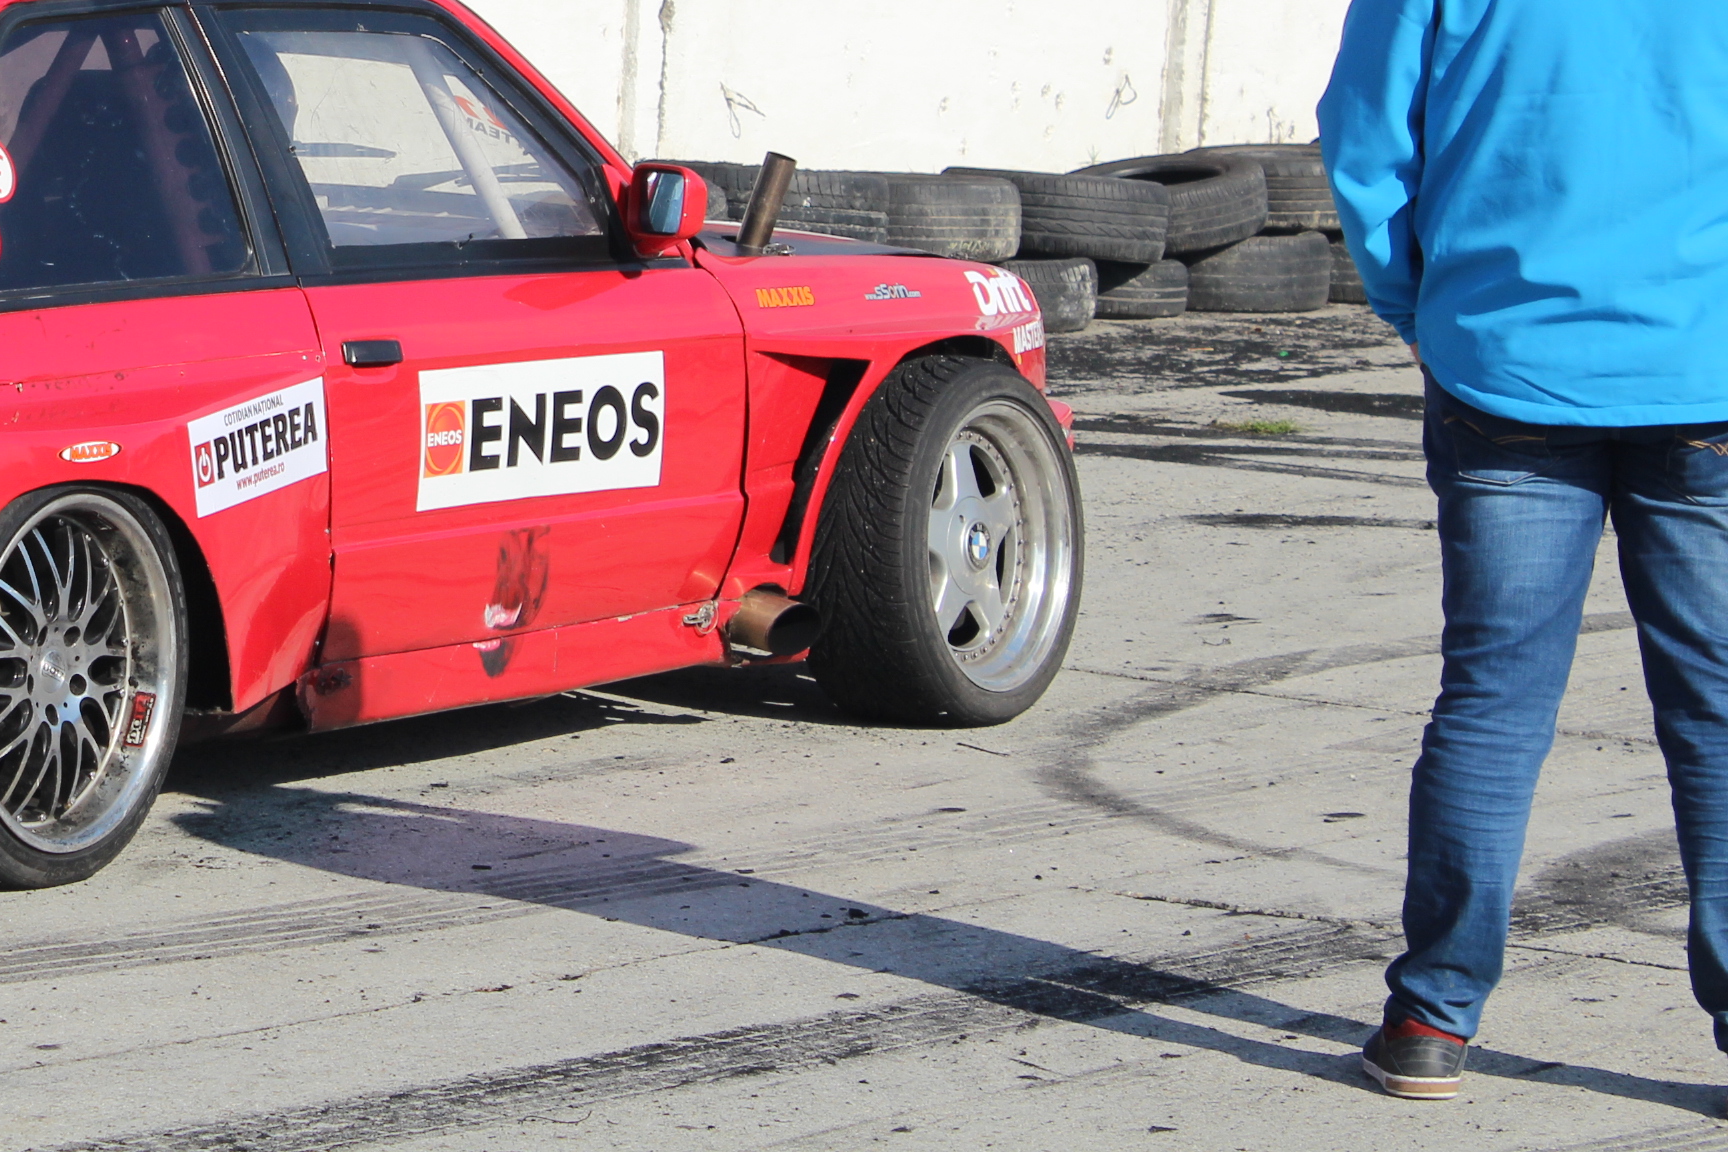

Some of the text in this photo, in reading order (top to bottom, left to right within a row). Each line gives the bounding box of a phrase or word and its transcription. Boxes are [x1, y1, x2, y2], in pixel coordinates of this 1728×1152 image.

[756, 286, 815, 308] MAXXIS
[963, 268, 1032, 316] Drift
[224, 404, 253, 426] COTIDIAN
[469, 381, 659, 472] ENEOS
[214, 401, 318, 481] PUTEREA
[427, 430, 462, 447] ENEOS
[236, 462, 285, 490] www.puterea.ro
